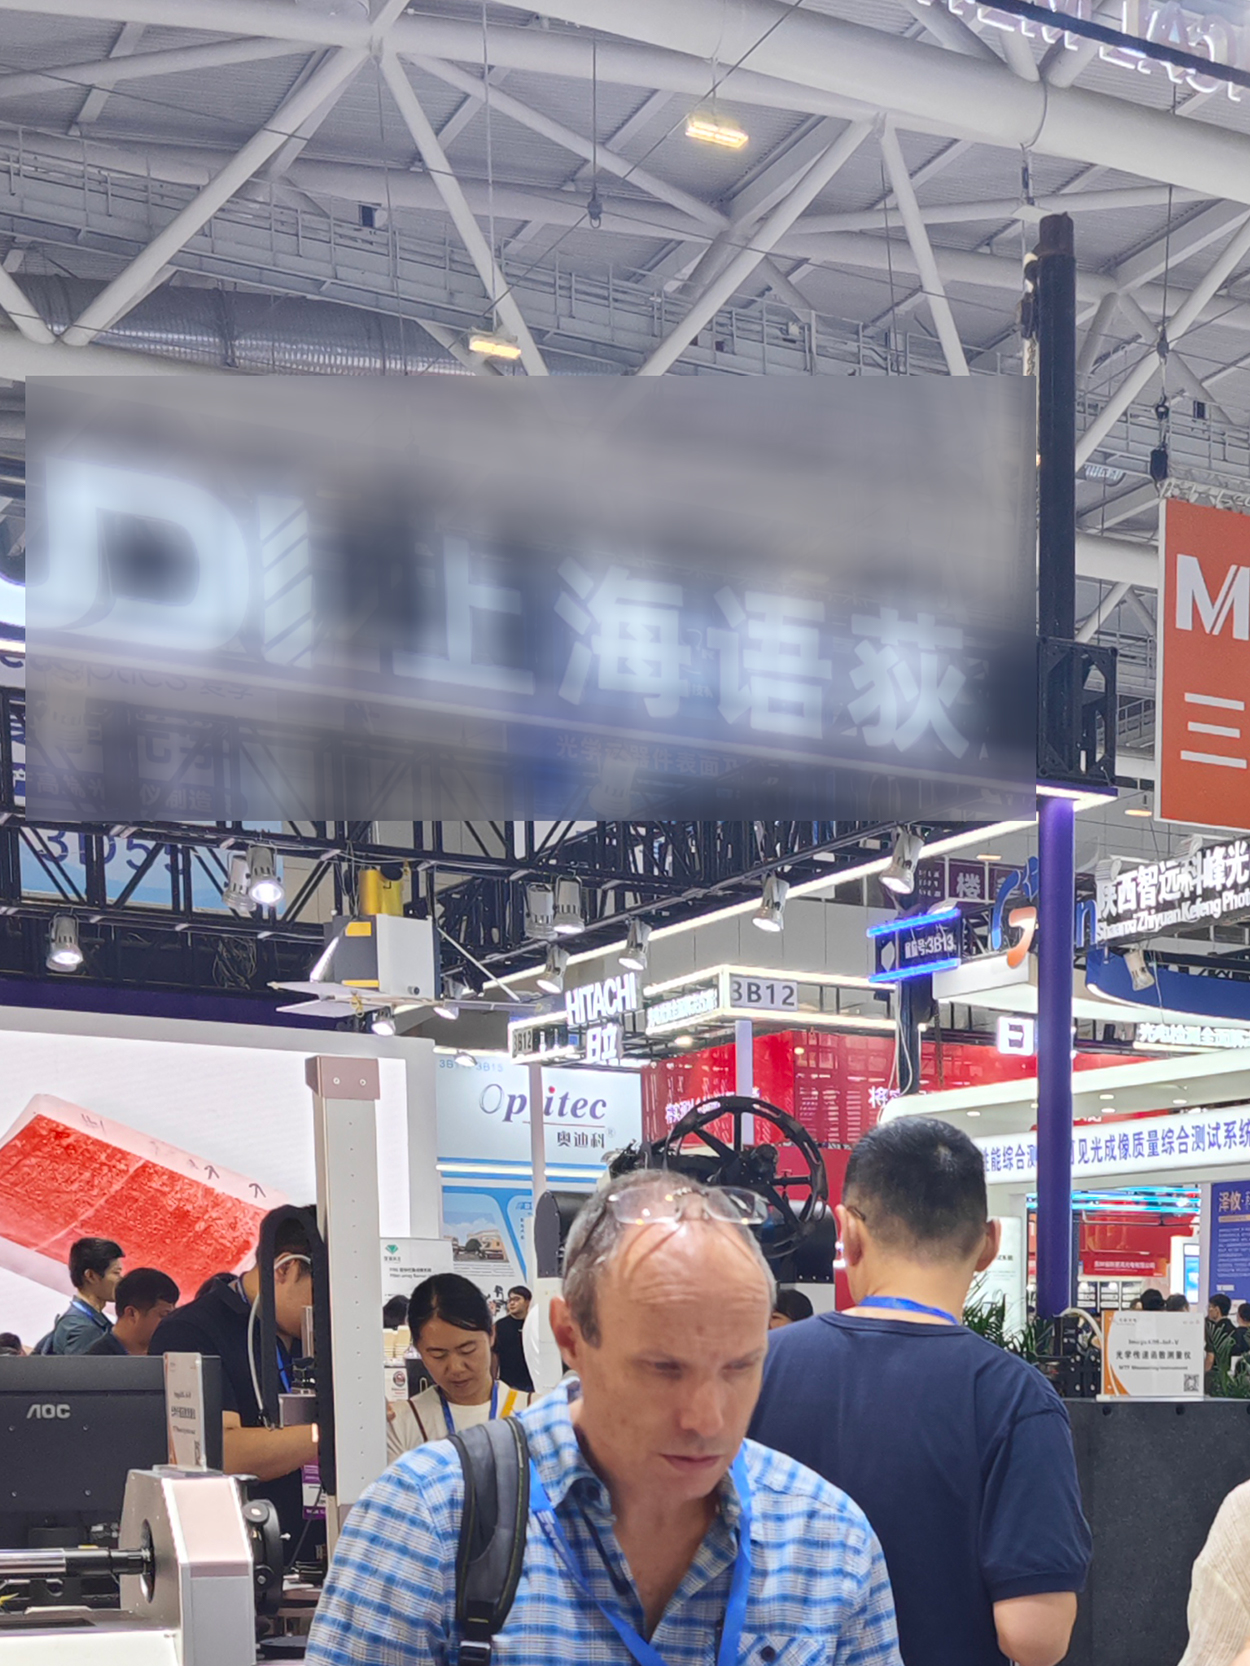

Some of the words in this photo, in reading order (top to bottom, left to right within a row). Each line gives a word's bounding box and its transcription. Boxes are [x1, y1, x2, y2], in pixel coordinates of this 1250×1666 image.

[1182, 899, 1222, 924] Kefeng
[565, 971, 637, 1028] HITACHI
[731, 979, 796, 1007] 3B12
[585, 1022, 619, 1063] 日立
[479, 1083, 607, 1122] Opitec
[26, 1403, 71, 1419] AOC
